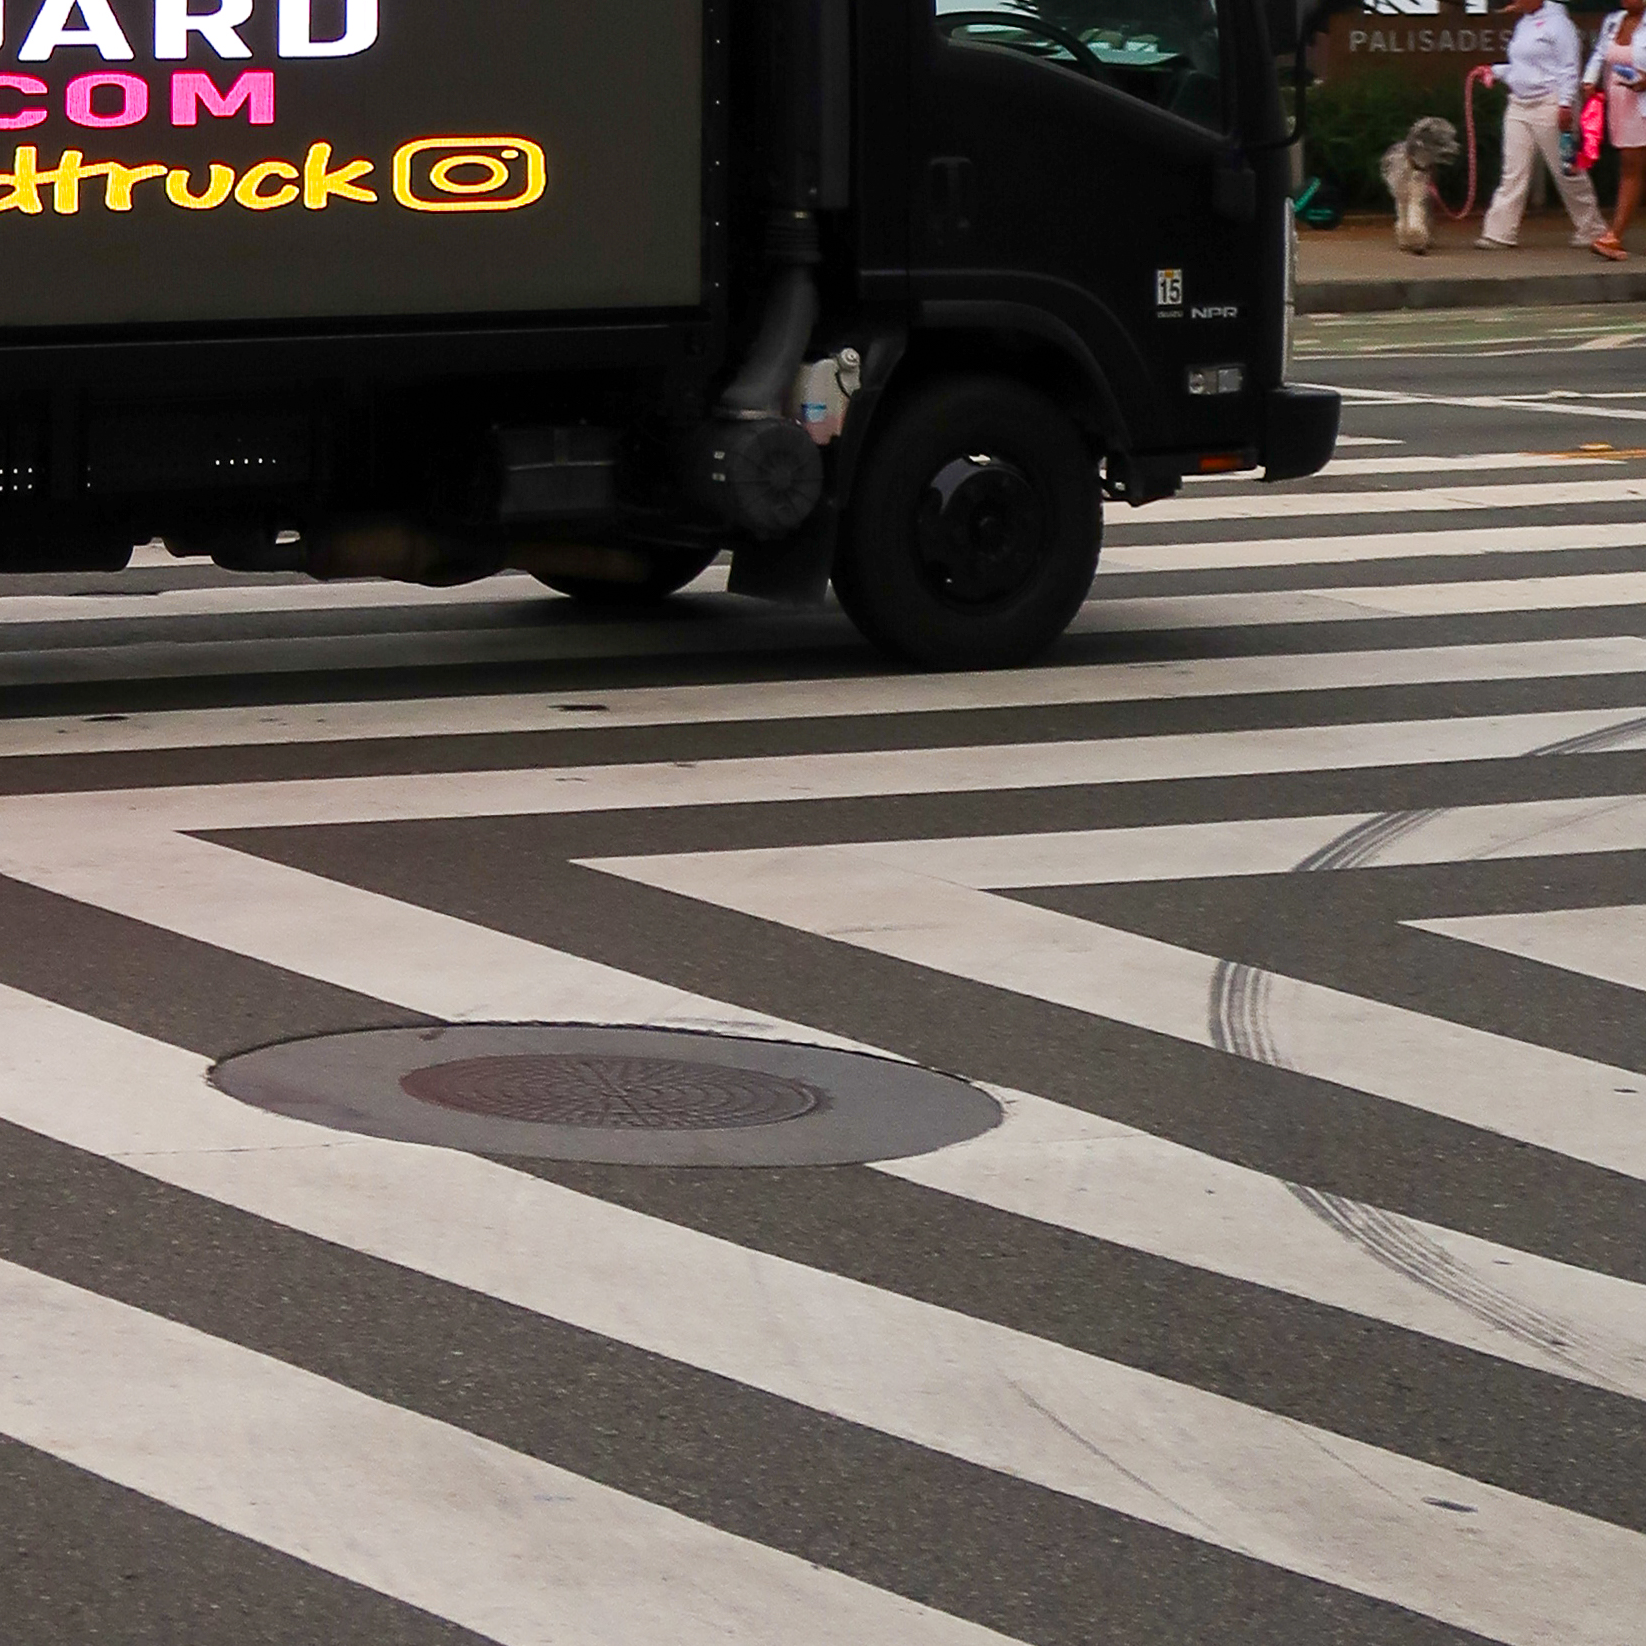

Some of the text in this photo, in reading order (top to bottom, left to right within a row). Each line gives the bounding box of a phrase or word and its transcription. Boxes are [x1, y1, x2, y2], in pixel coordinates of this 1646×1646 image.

[1348, 29, 1512, 53] PALISADES
[1160, 278, 1181, 303] 15
[1191, 306, 1238, 319] NPR
